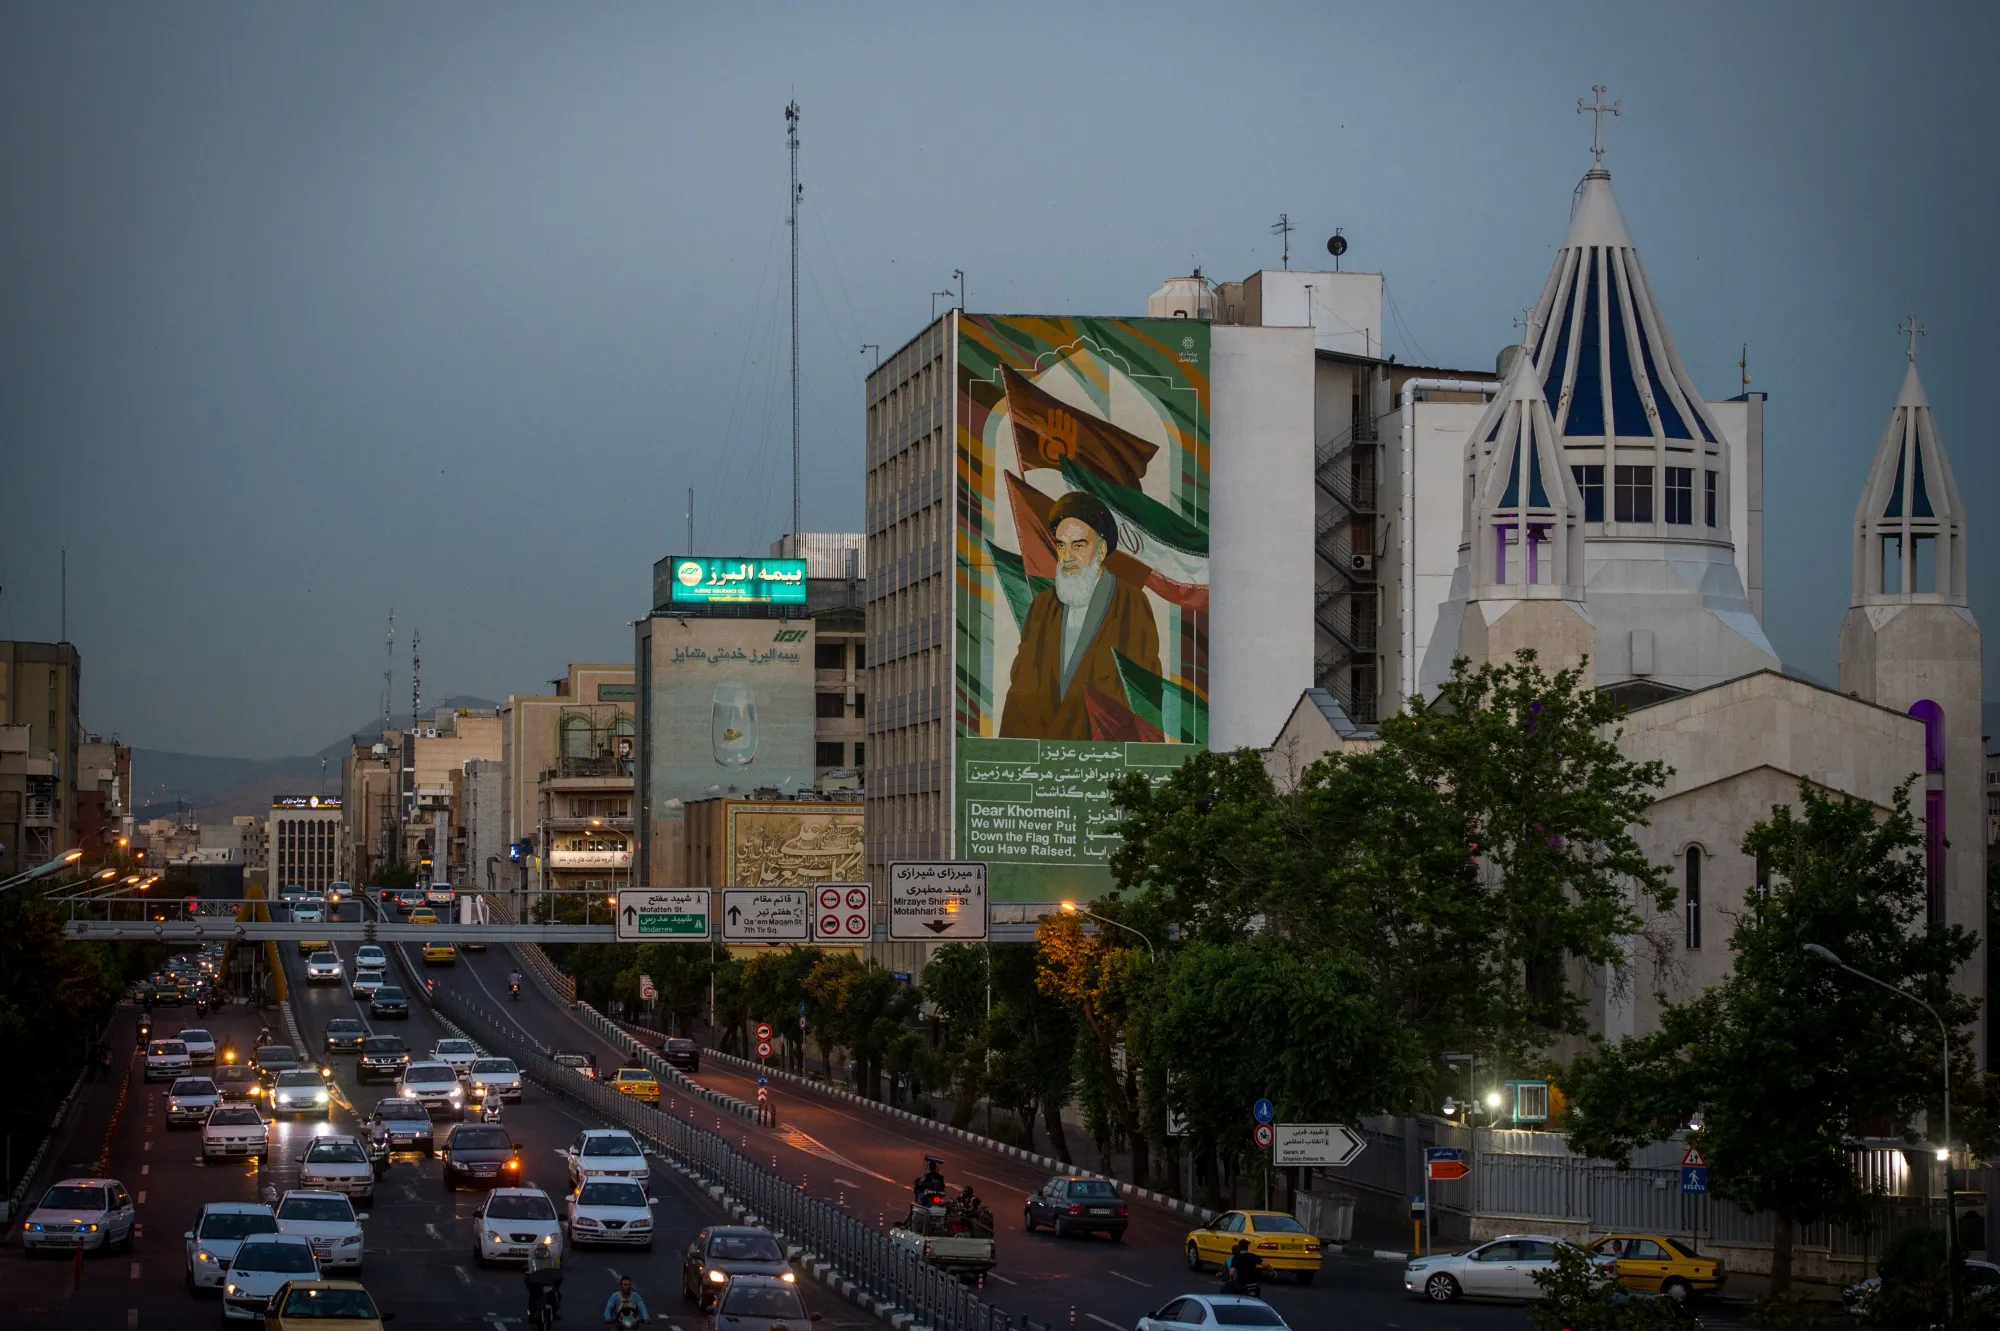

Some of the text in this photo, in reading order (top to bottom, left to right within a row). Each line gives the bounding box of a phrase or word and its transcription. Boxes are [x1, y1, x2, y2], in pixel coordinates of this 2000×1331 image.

[706, 563, 802, 586] بیمه البرز
[670, 646, 801, 664] بیمه البرز خدمتی متمایز
[1078, 746, 1123, 762] خمینی
[970, 765, 1000, 781] زمین
[1001, 768, 1015, 782] به
[1015, 765, 1054, 782] هرگز
[1055, 767, 1110, 783] برافراشتی
[1035, 785, 1084, 799] گذاشت
[971, 803, 1004, 817] Dear
[971, 818, 1077, 833] We Will Never Put
[971, 830, 1077, 846] Down the Flag That
[971, 843, 1077, 857] You Have Raised.
[897, 867, 973, 881] میرزای شیرازی
[906, 884, 972, 896] شهید مطهری
[648, 894, 692, 906] شهید مفتح
[753, 894, 792, 907] قائم مقام
[893, 897, 971, 906] Mirzaye Shirazi St.
[756, 908, 792, 919] هفتم تیر
[893, 907, 937, 915] Motahhari
[640, 914, 693, 925] شهید مدرس
[769, 918, 793, 926] Maqam
[767, 926, 779, 934] Sq.
